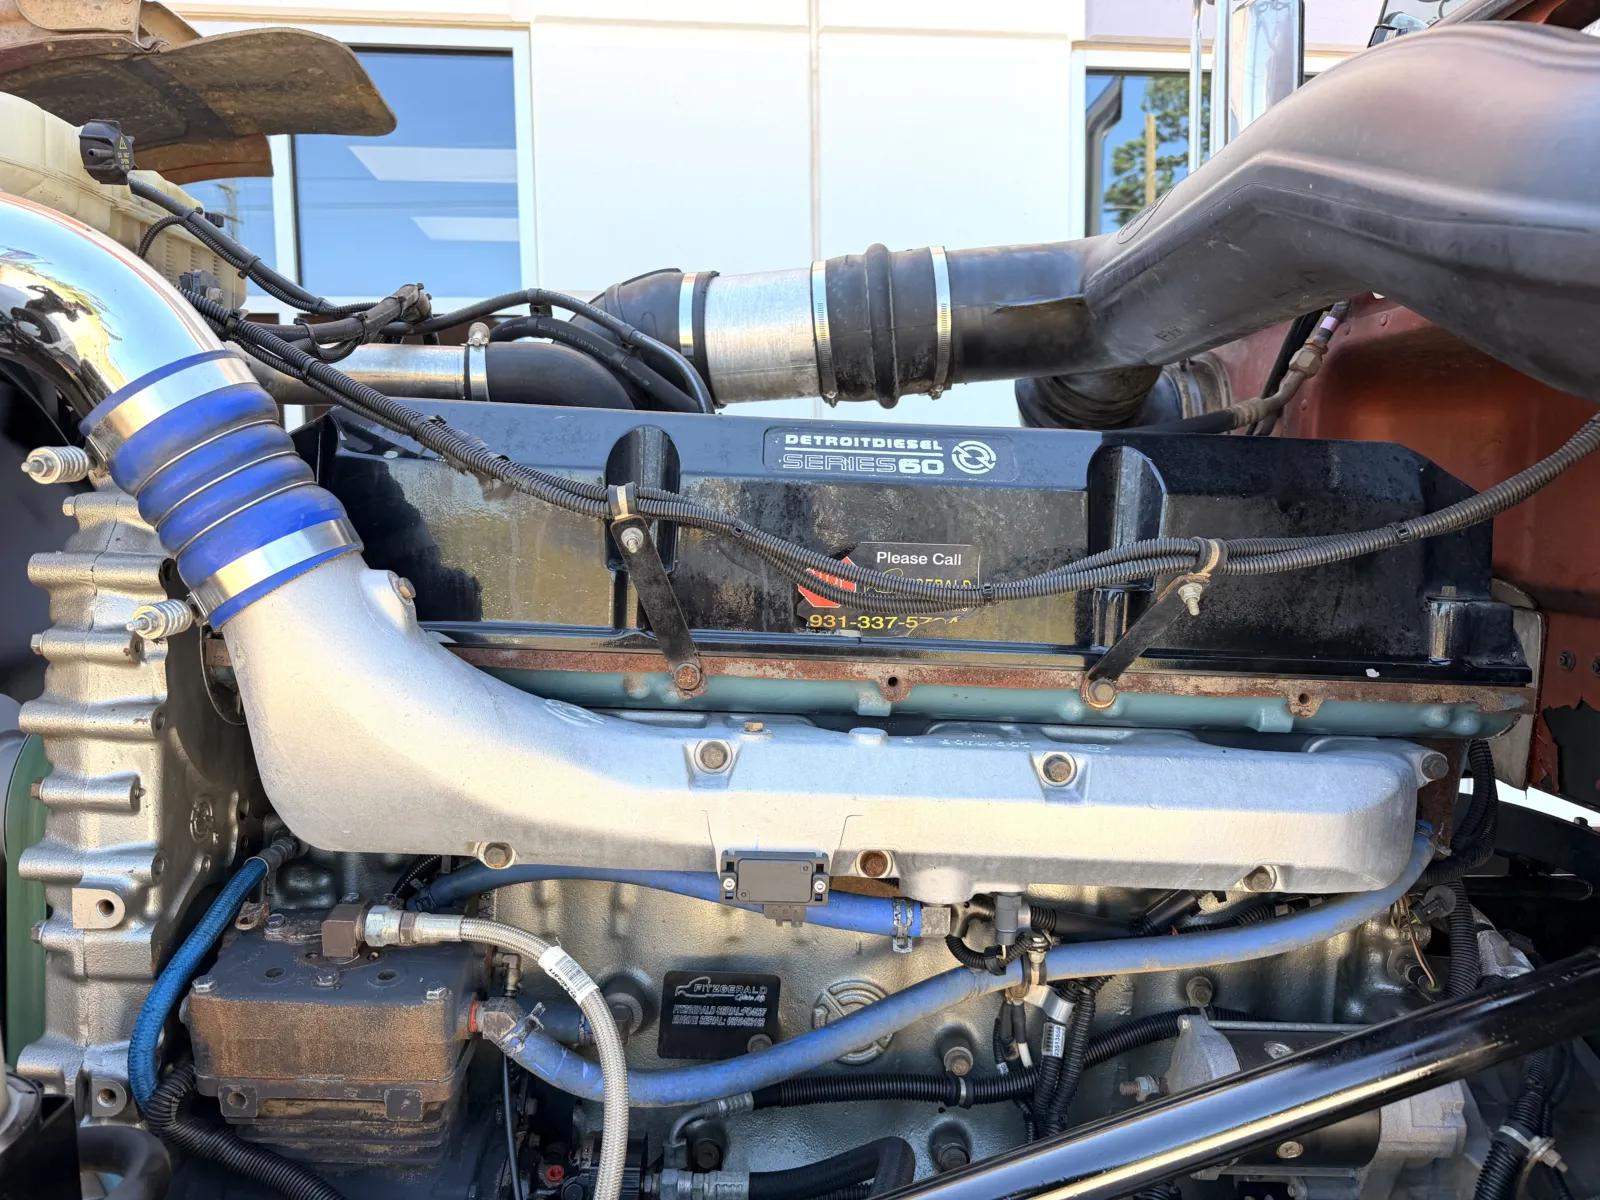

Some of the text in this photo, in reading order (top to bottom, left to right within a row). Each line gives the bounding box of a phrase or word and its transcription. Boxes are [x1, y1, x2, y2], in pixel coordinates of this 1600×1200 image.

[783, 453, 945, 475] SERIES 60
[876, 551, 962, 566] Please Call
[693, 983, 768, 995] FITZGERALD
